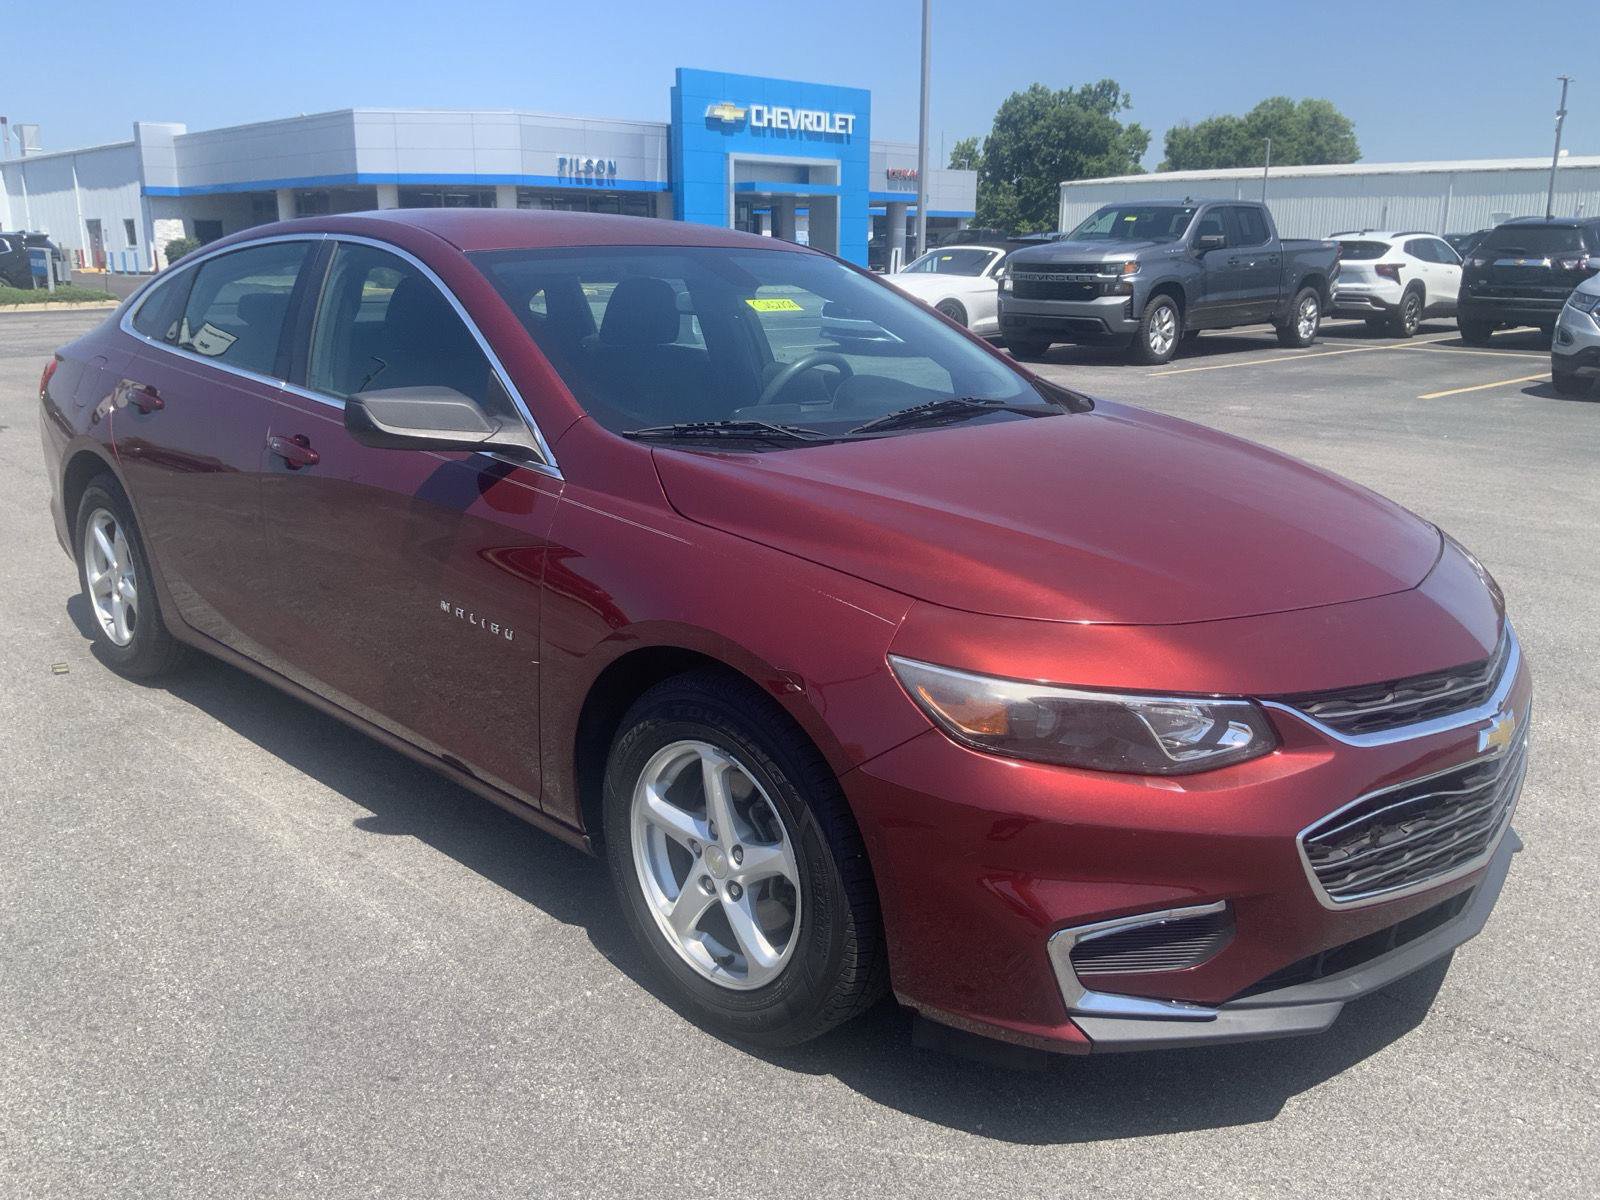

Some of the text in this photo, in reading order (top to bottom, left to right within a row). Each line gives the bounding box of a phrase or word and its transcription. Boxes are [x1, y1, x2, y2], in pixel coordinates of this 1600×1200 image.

[750, 104, 856, 135] CHEVROLET
[1013, 272, 1097, 282] CHEVROLET
[440, 600, 514, 640] MALIBU
